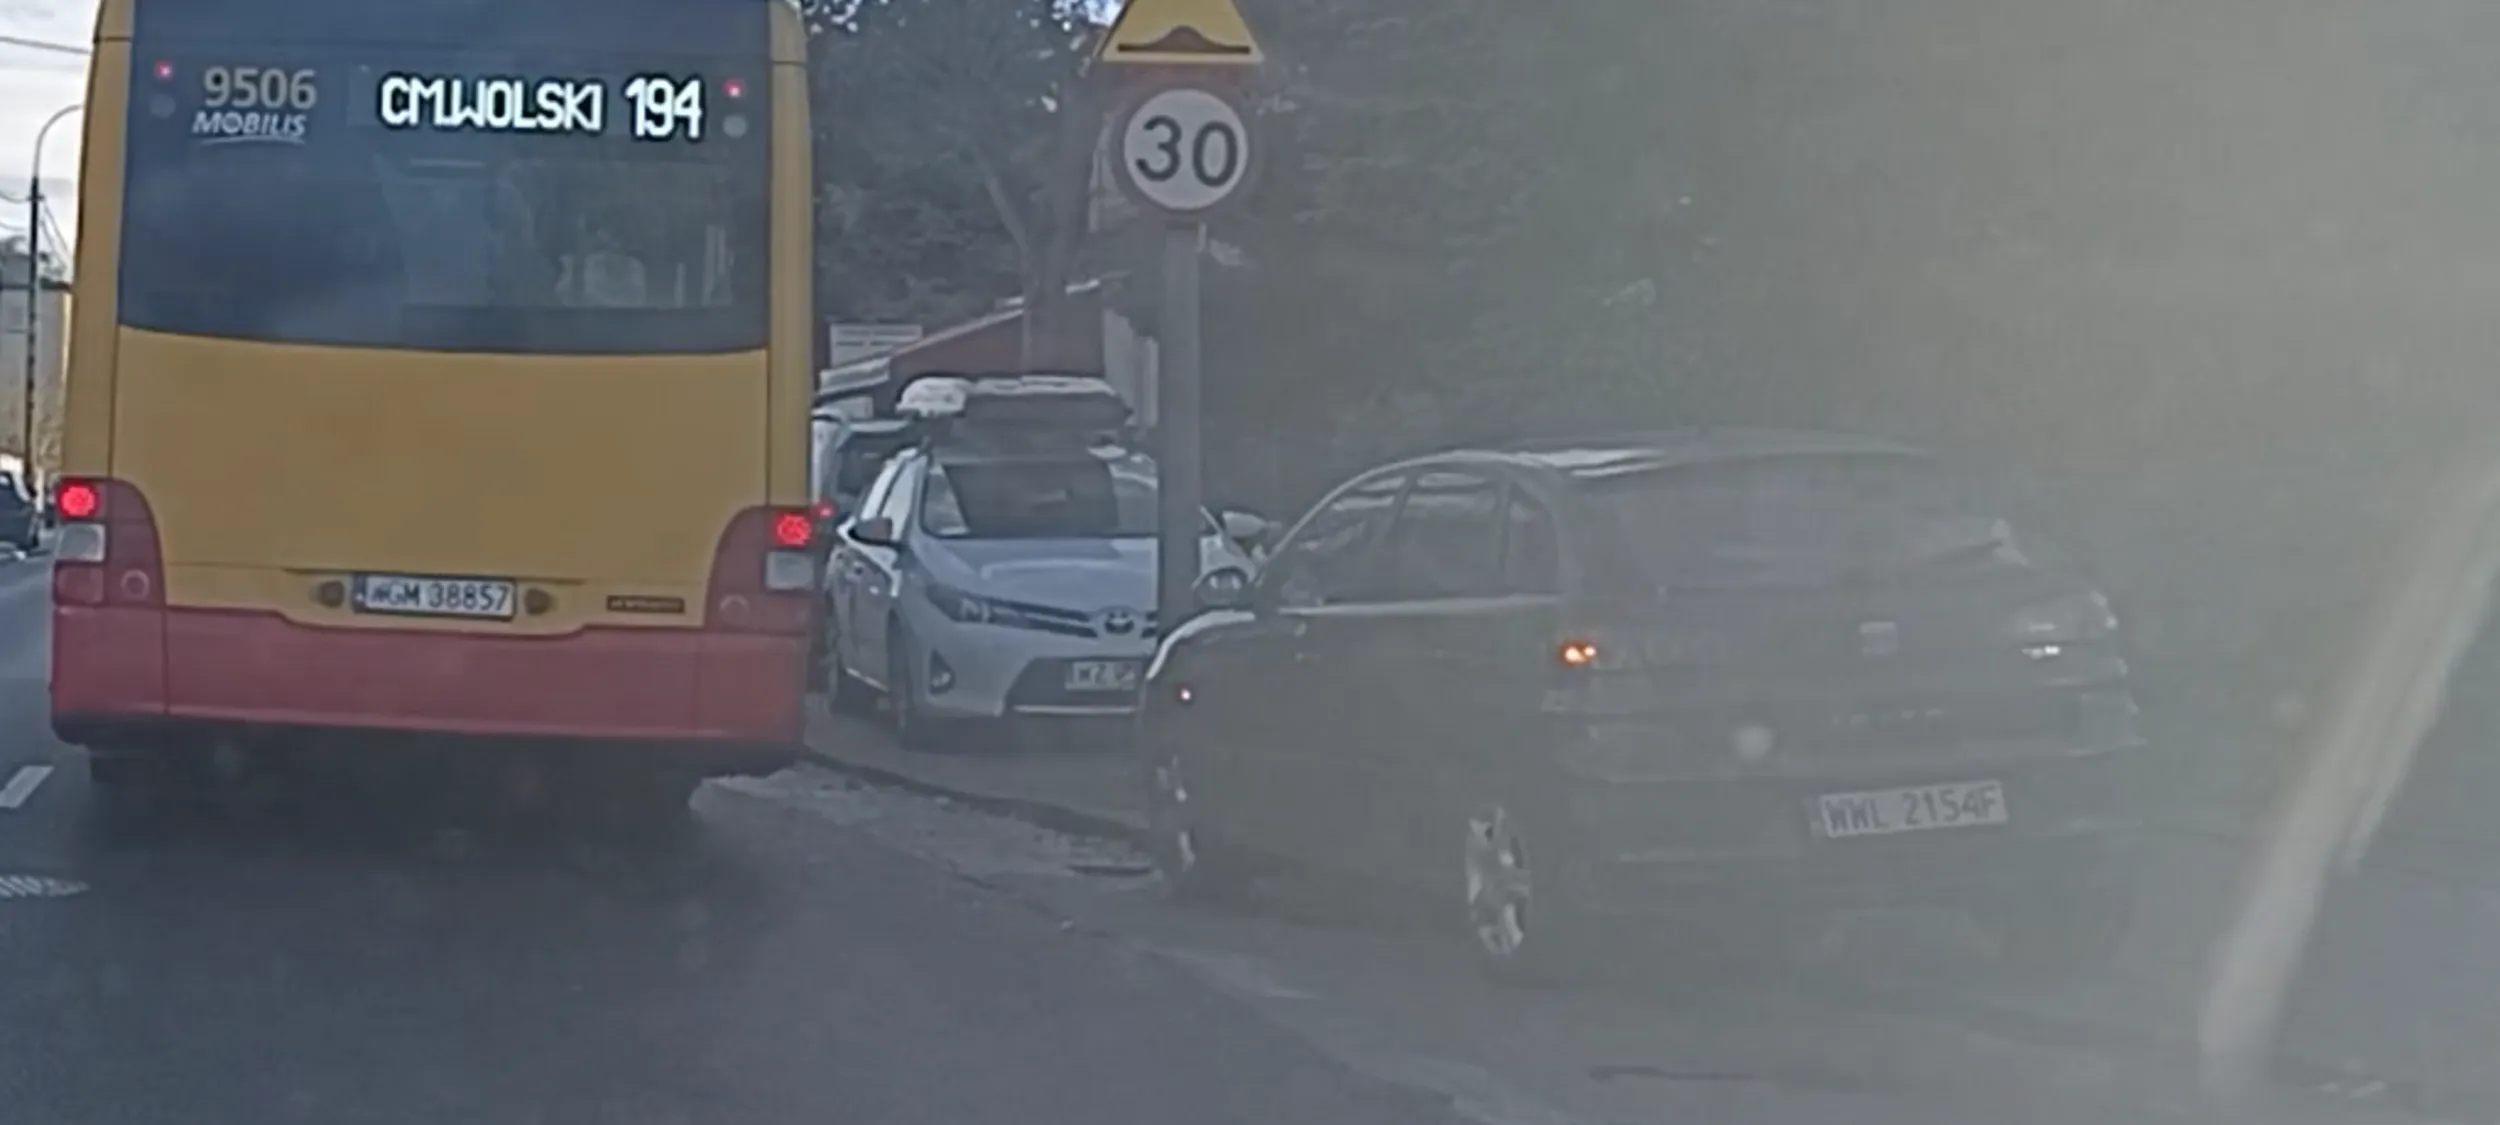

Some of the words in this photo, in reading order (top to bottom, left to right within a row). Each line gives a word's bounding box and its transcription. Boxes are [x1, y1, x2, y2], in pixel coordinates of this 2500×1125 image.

[204, 65, 318, 110] 9506
[624, 77, 703, 139] 194
[191, 110, 308, 138] MOBILIS
[1135, 116, 1239, 188] 30
[427, 582, 510, 611] 38857
[1824, 797, 1890, 832] WWL
[1901, 786, 1997, 826] 2154F
